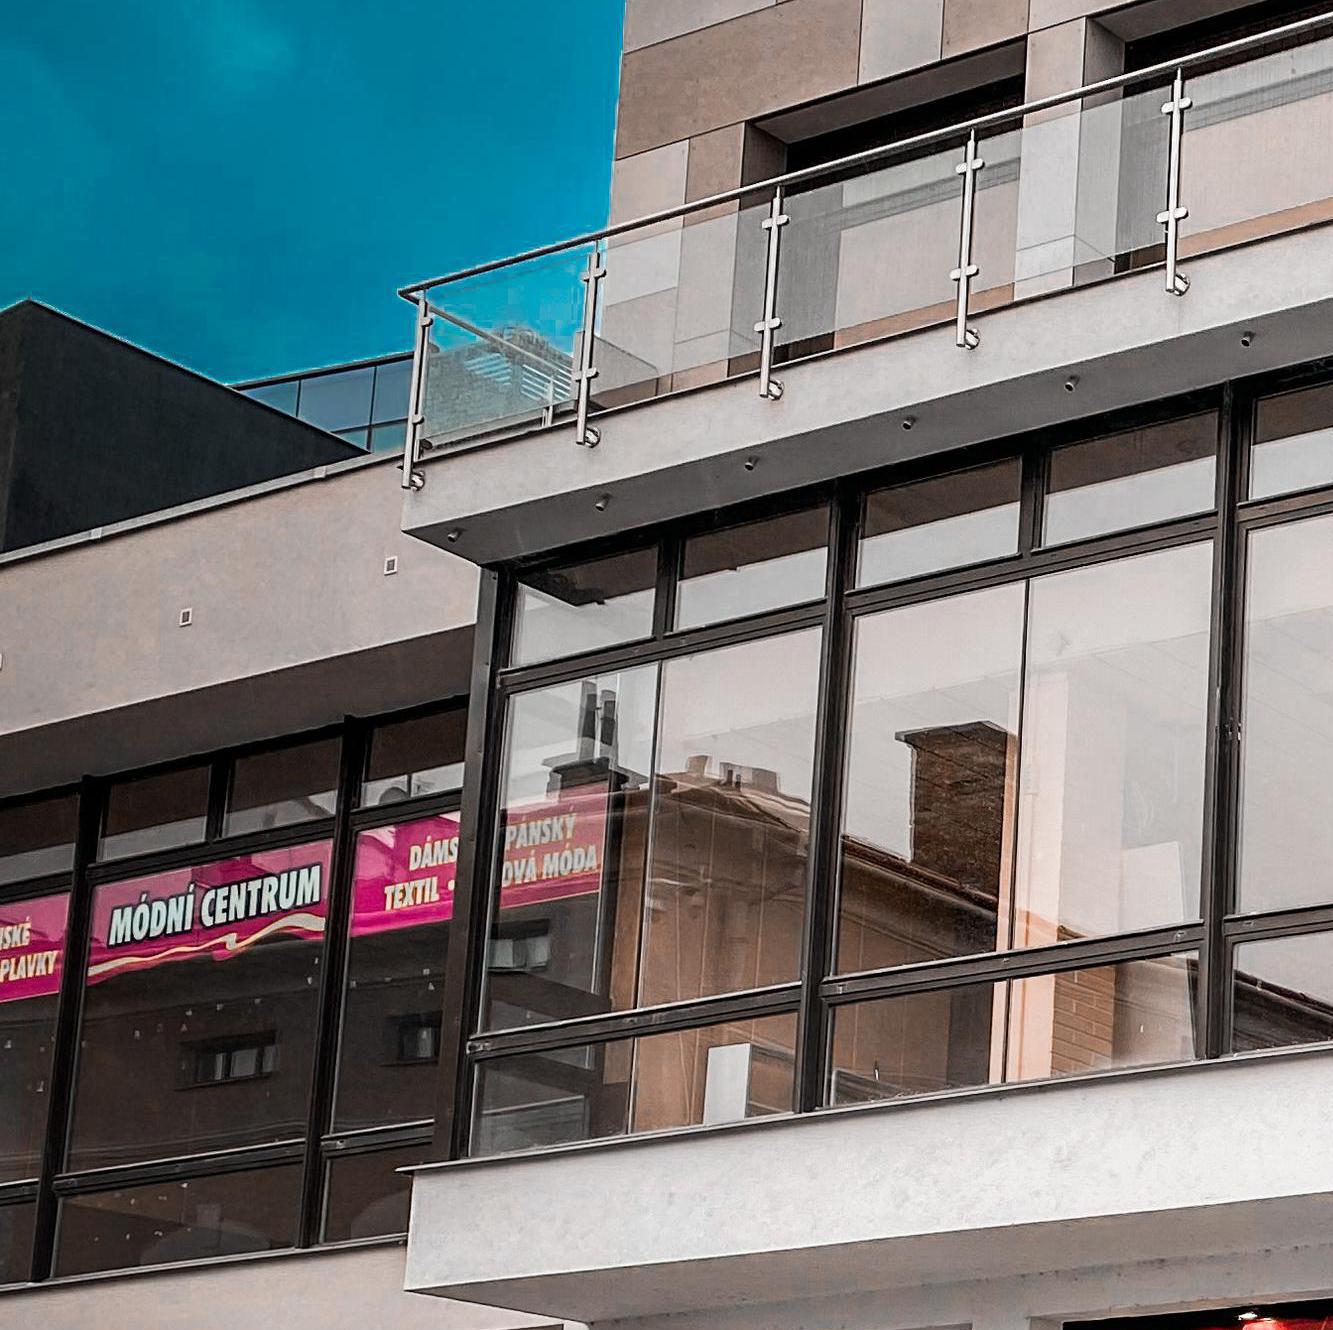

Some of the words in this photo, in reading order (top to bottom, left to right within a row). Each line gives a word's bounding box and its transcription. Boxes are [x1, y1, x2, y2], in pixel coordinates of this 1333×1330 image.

[108, 883, 196, 946] MÓDNÍ
[200, 864, 322, 928] CENTRUM
[384, 875, 440, 911] TEXTIL
[543, 844, 598, 879] MÓDA
[0, 950, 59, 983] PLAVKY
